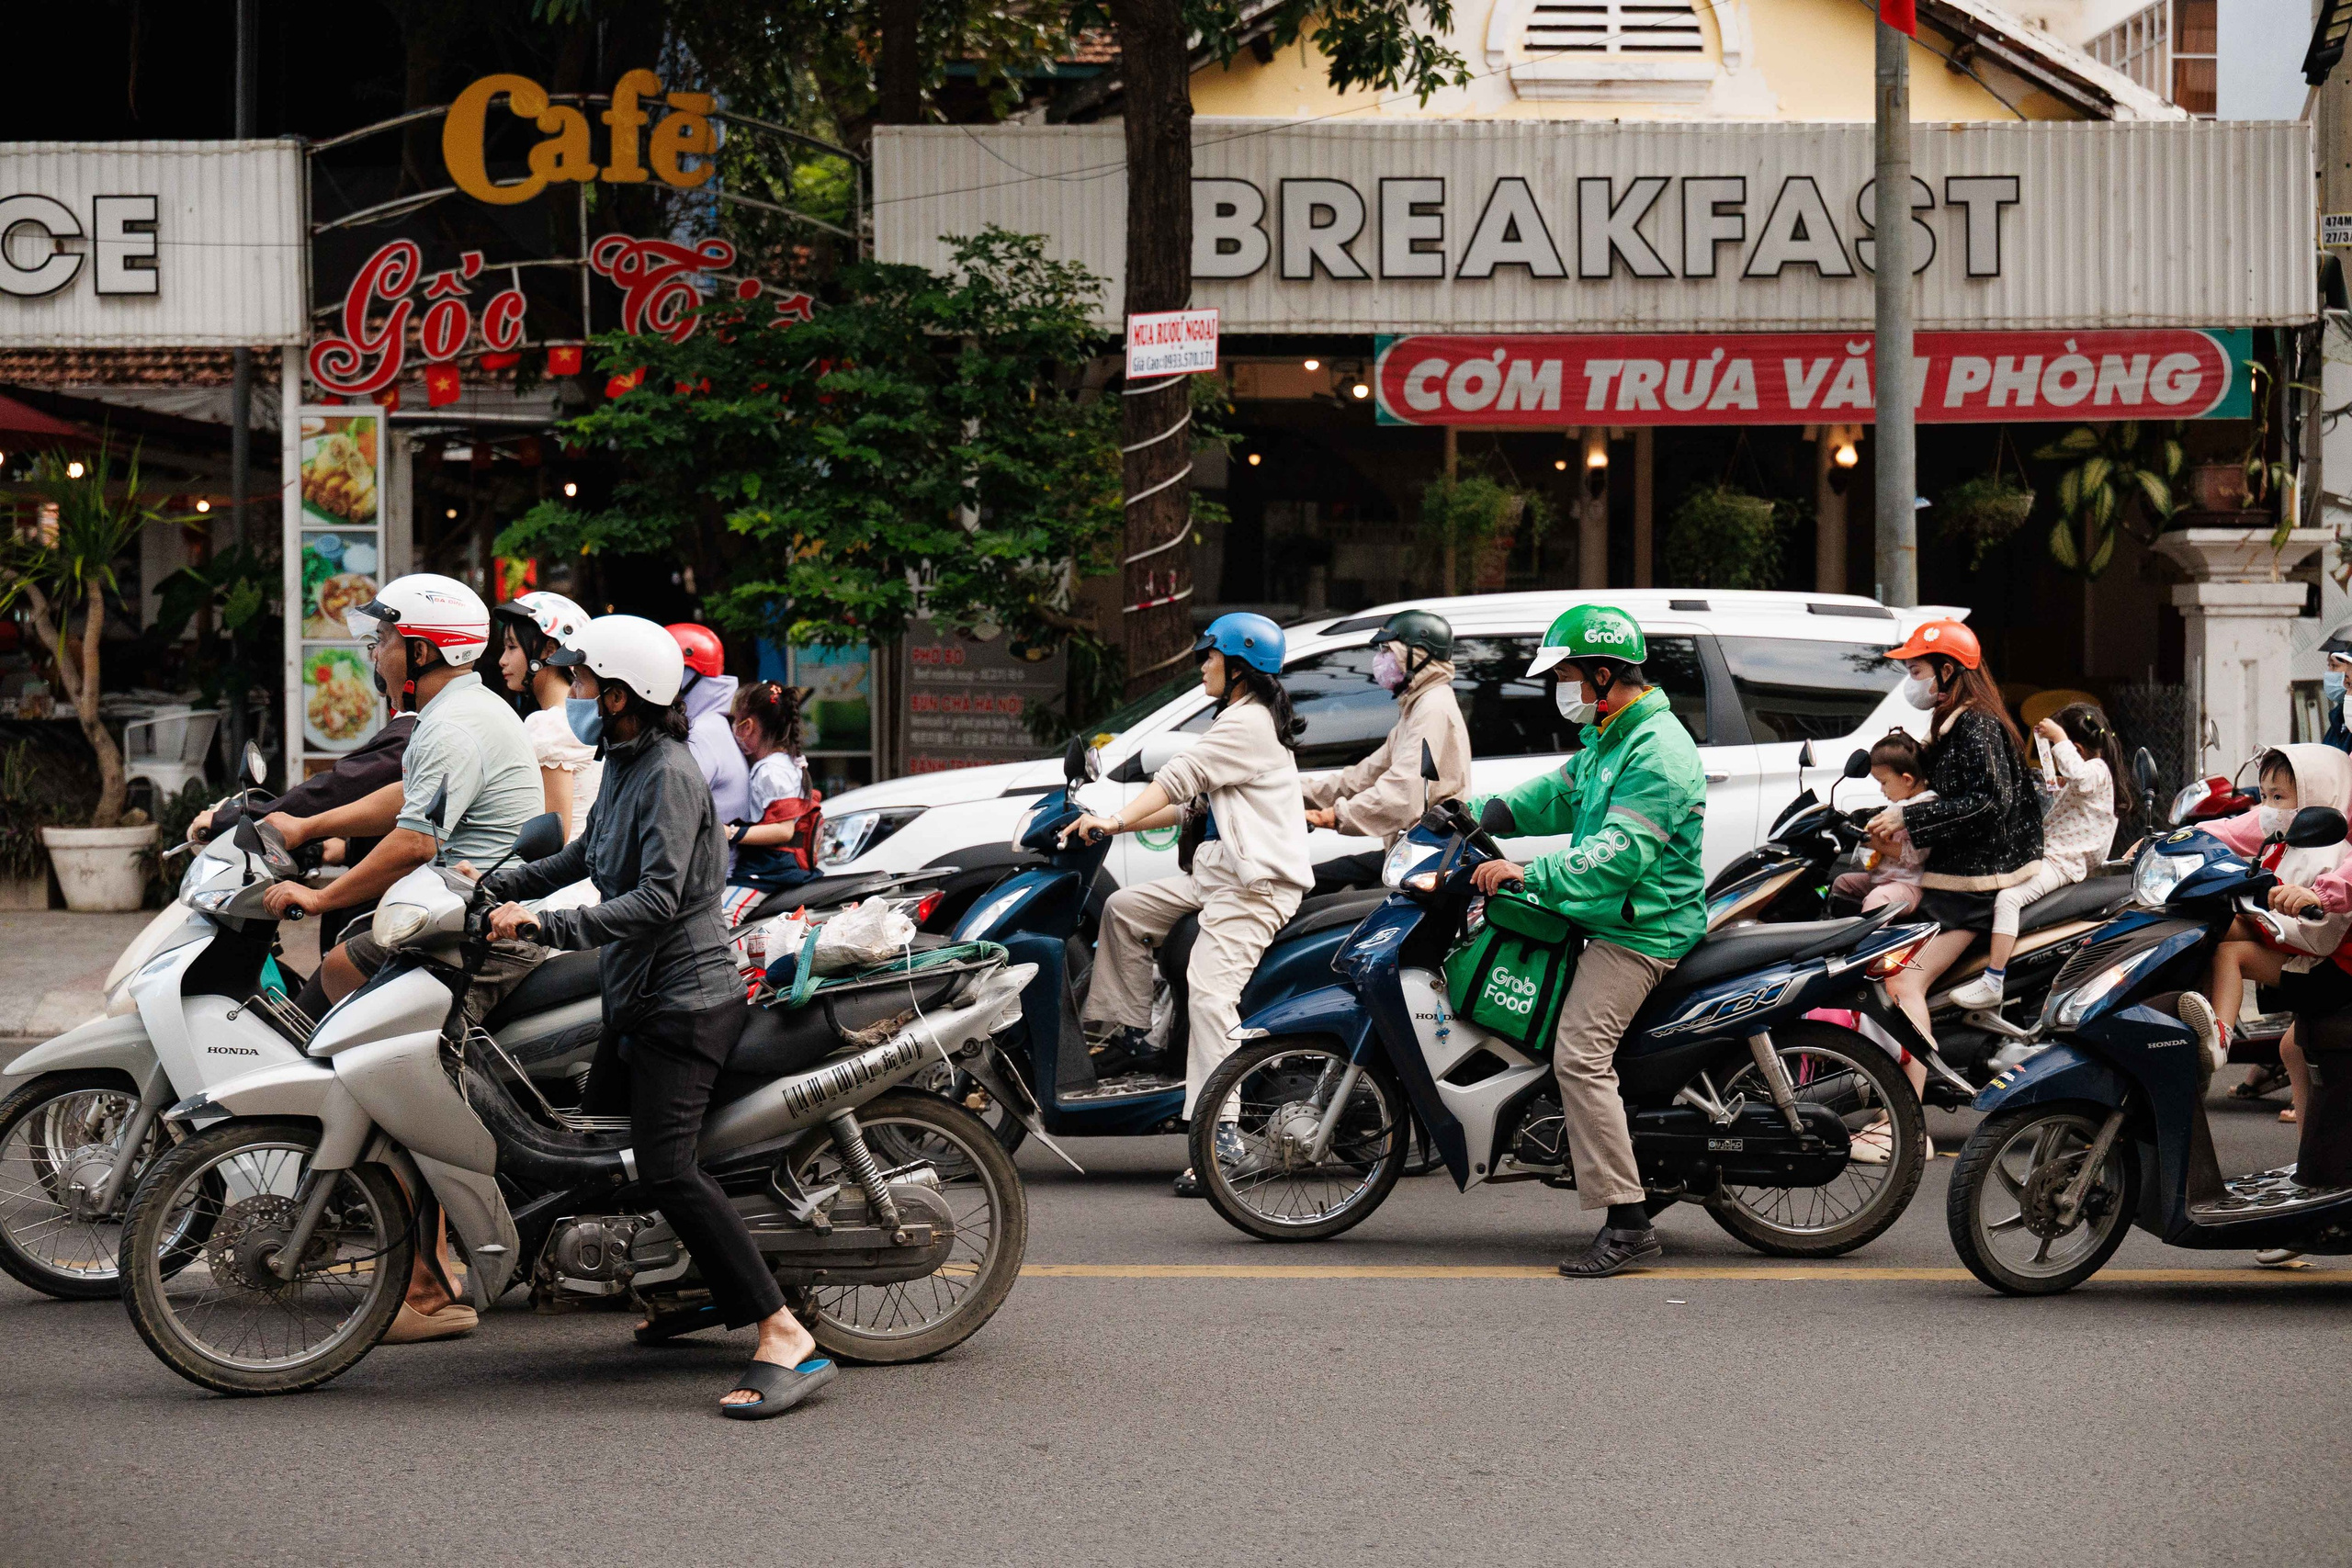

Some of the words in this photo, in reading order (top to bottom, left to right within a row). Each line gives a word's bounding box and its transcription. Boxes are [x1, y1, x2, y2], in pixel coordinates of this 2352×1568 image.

[1191, 175, 2020, 282] BREAKFAST
[309, 238, 527, 396] Gốc
[1133, 323, 1154, 347] MUA
[1403, 348, 1564, 412] CƠM
[1583, 347, 1759, 412] TRƯA
[1943, 338, 2204, 408] PHÒNG
[1584, 628, 1626, 645] Grab
[1564, 829, 1632, 875] Grab
[1492, 966, 1537, 997] Grab
[1484, 983, 1533, 1015] Food
[207, 1046, 260, 1056] HONDA
[2147, 1039, 2188, 1049] HONDA
